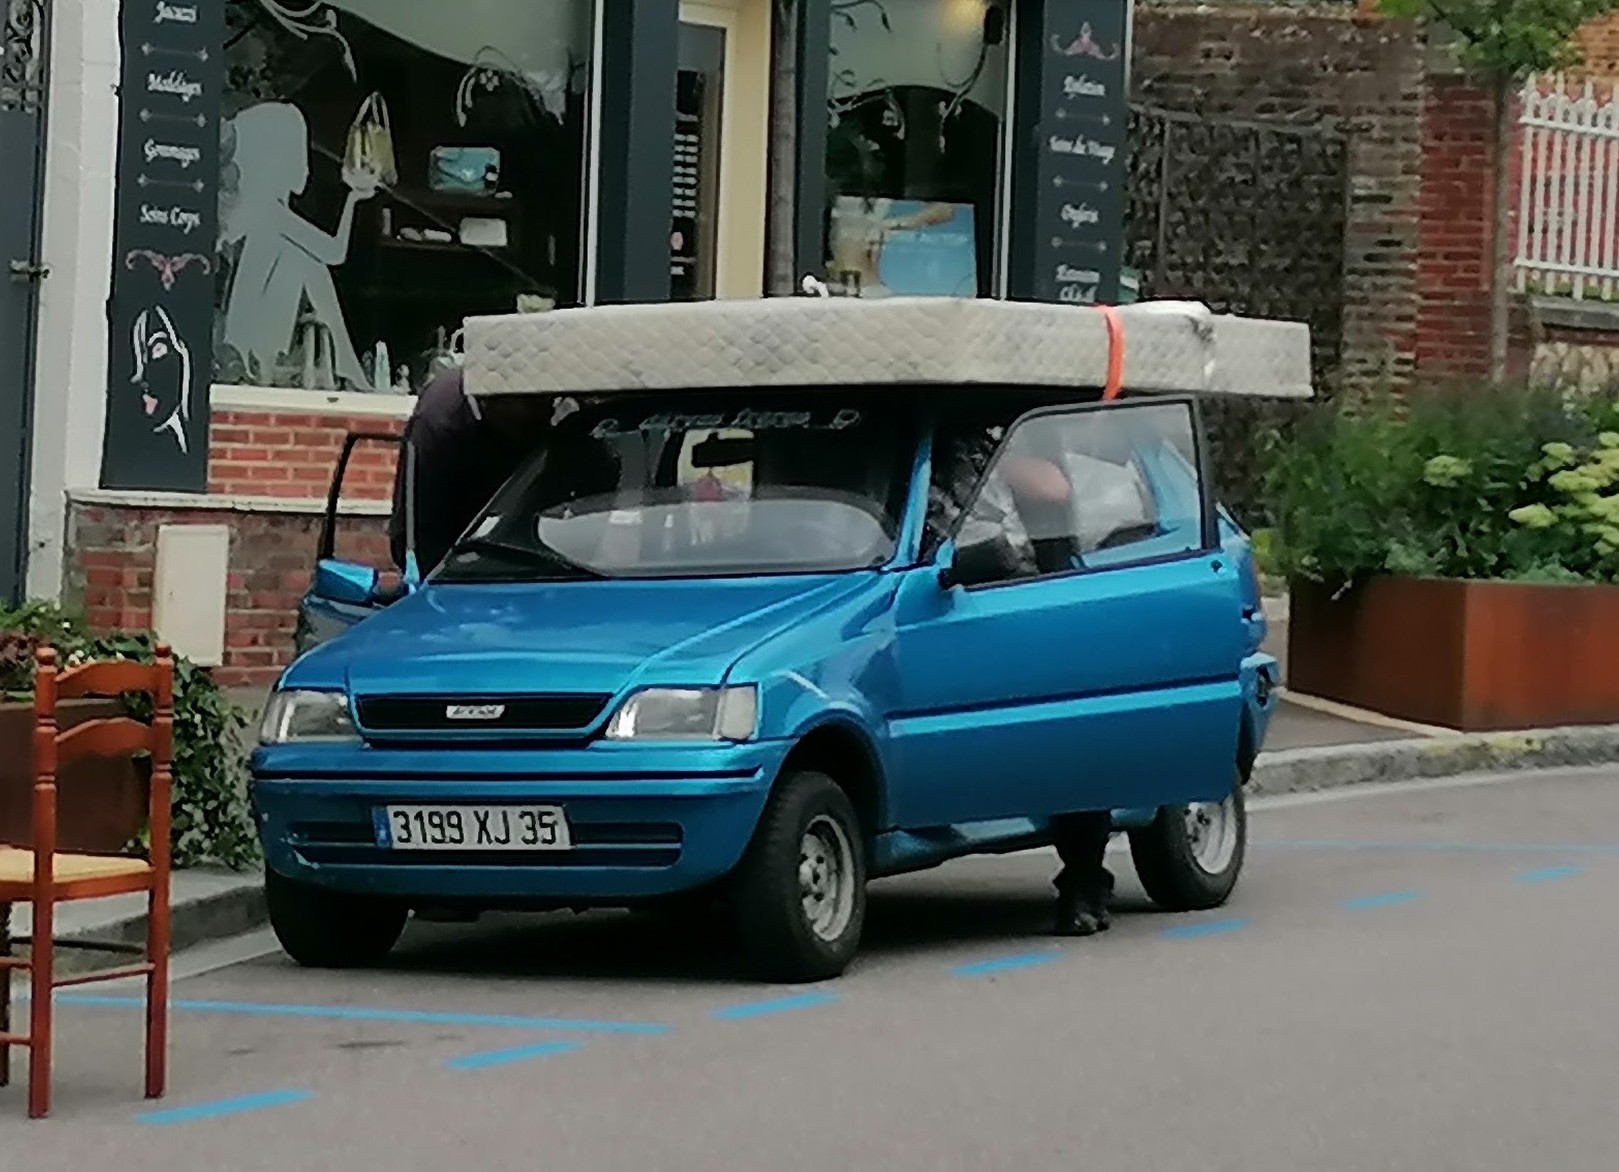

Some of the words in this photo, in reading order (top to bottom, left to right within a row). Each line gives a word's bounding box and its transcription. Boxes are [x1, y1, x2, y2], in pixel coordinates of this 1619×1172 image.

[393, 810, 465, 844] 3199
[473, 810, 511, 845] XJ
[518, 811, 559, 845] 35
